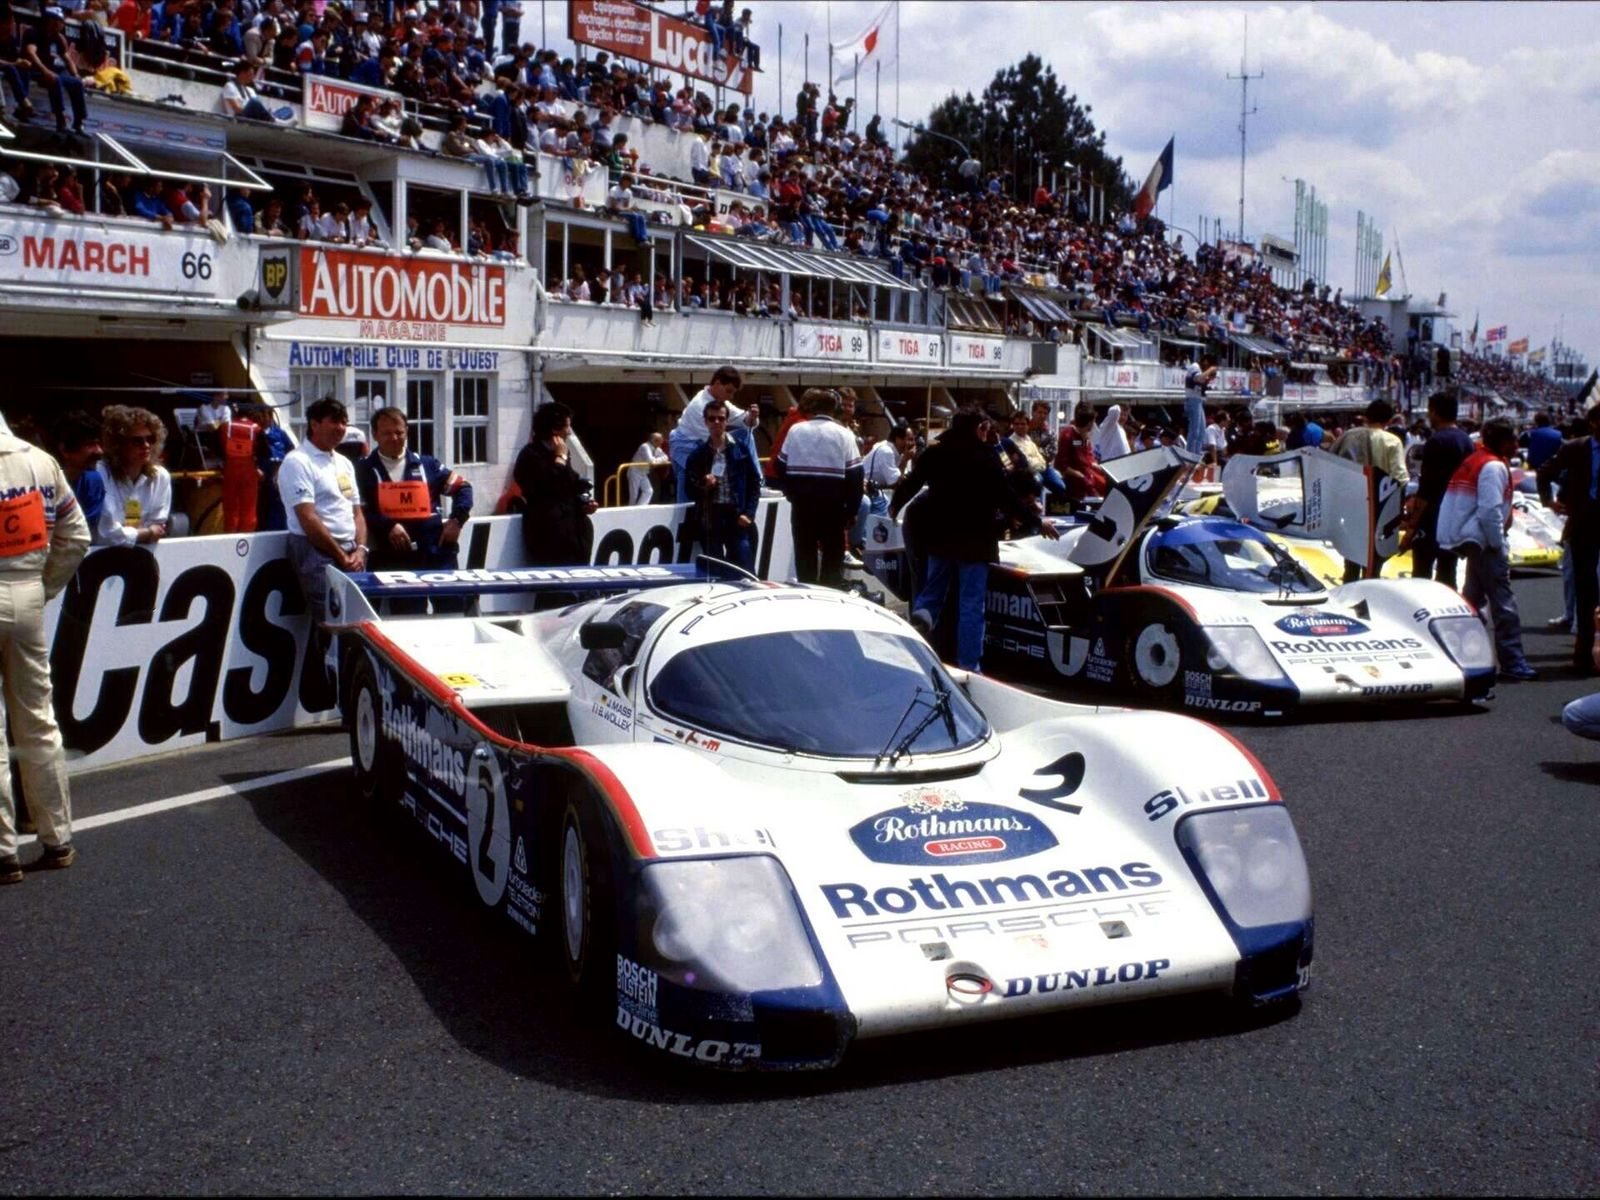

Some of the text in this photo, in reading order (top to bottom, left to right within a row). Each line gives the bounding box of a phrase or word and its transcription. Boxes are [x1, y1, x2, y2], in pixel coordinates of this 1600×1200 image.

[23, 236, 150, 276] MARCH
[182, 252, 212, 280] 66
[265, 263, 285, 285] BP
[360, 320, 447, 342] MAGAZINE
[817, 334, 843, 353] TIGA
[851, 336, 863, 353] 99
[899, 338, 939, 358] TIGA 97
[968, 343, 985, 359] TIGA
[289, 342, 379, 367] AUTOMOBILE
[386, 346, 420, 368] CLUB
[427, 349, 442, 369] DE
[400, 491, 413, 505] M
[4, 514, 20, 535] C
[374, 565, 672, 585] Rothmans
[875, 558, 897, 571] Shell
[1284, 611, 1356, 628] Rothmans
[1270, 635, 1422, 655] Rothmans
[1361, 683, 1433, 696] DUNLOP
[1184, 694, 1262, 712] DUNLOP
[1018, 751, 1086, 815] 2
[874, 815, 1031, 844] Rothmans
[938, 838, 992, 853] RACING
[819, 862, 1163, 919] Rothmans
[846, 899, 1168, 949] PORSCHE
[617, 953, 658, 992] BOSCH
[1001, 957, 1171, 998] DUNLOP
[617, 972, 657, 1008] BILSTEIN
[616, 1006, 762, 1062] DUNLOP
